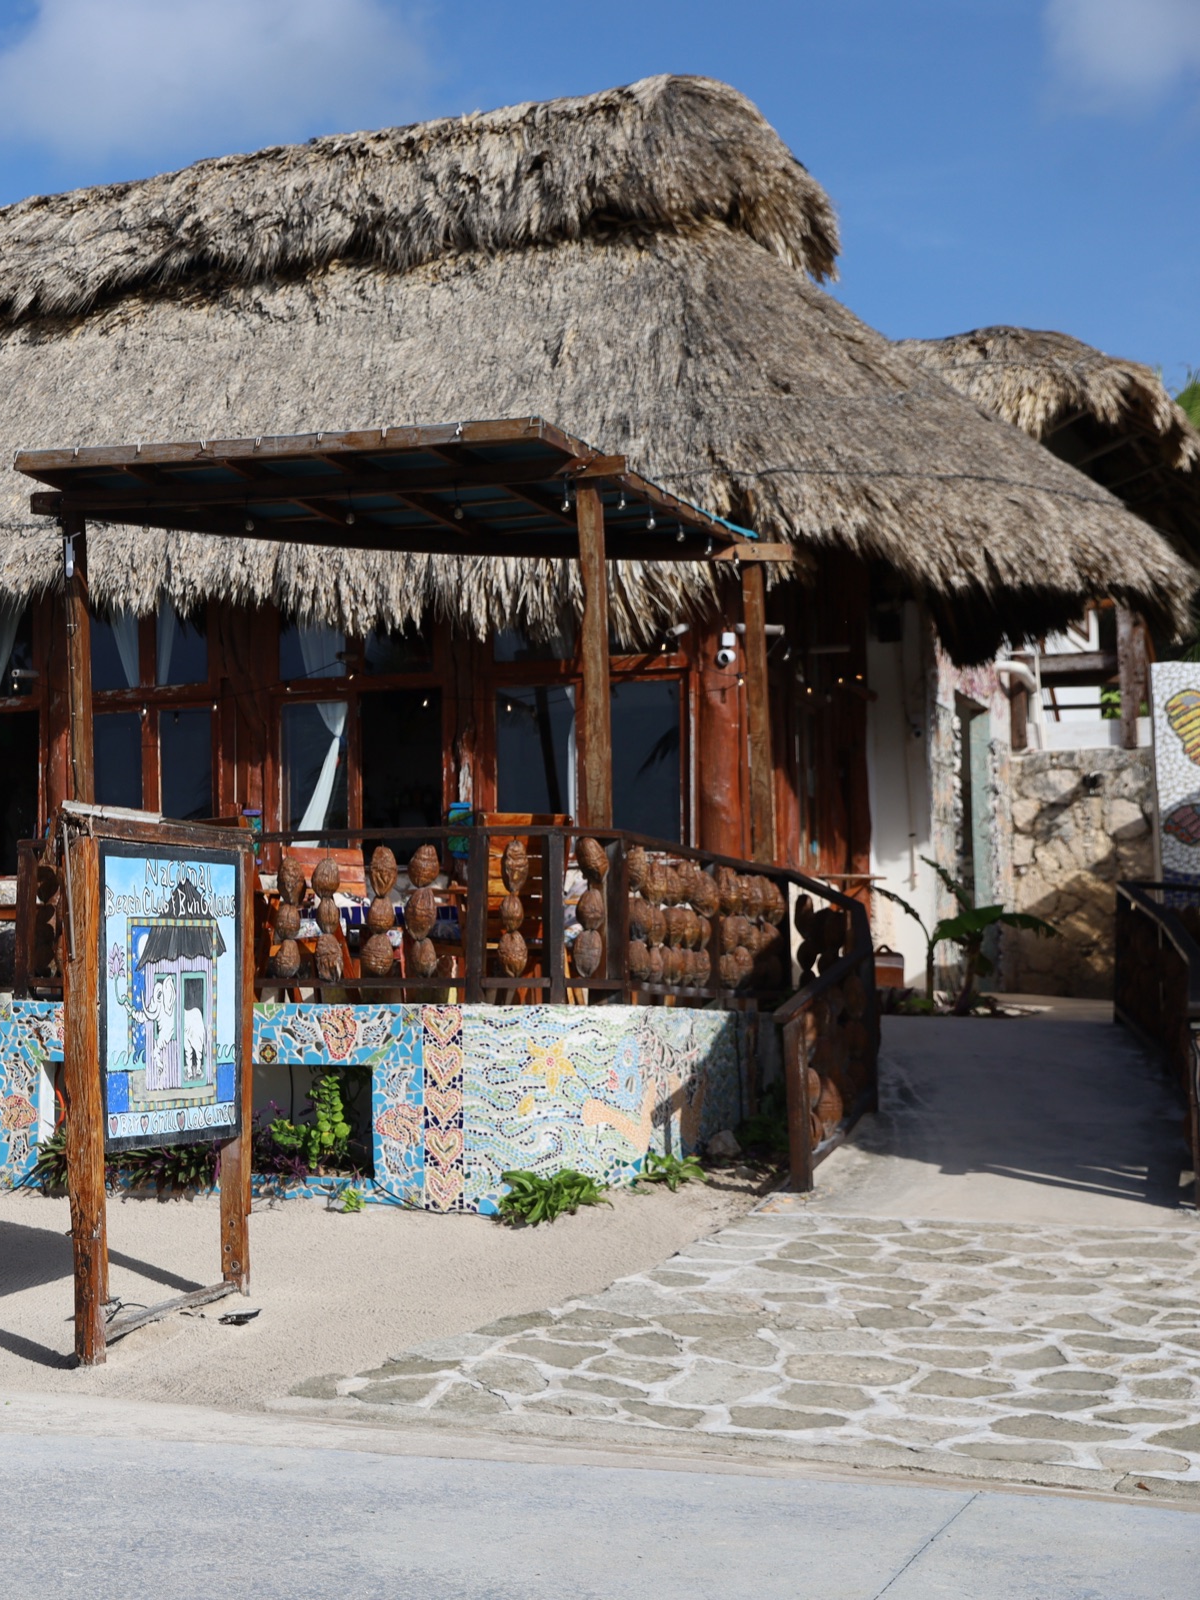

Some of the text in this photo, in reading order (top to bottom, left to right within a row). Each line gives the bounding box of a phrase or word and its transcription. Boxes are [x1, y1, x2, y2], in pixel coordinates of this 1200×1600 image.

[104, 885, 141, 919] Beach
[120, 1114, 140, 1137] Bar
[151, 1110, 177, 1134] Grill
